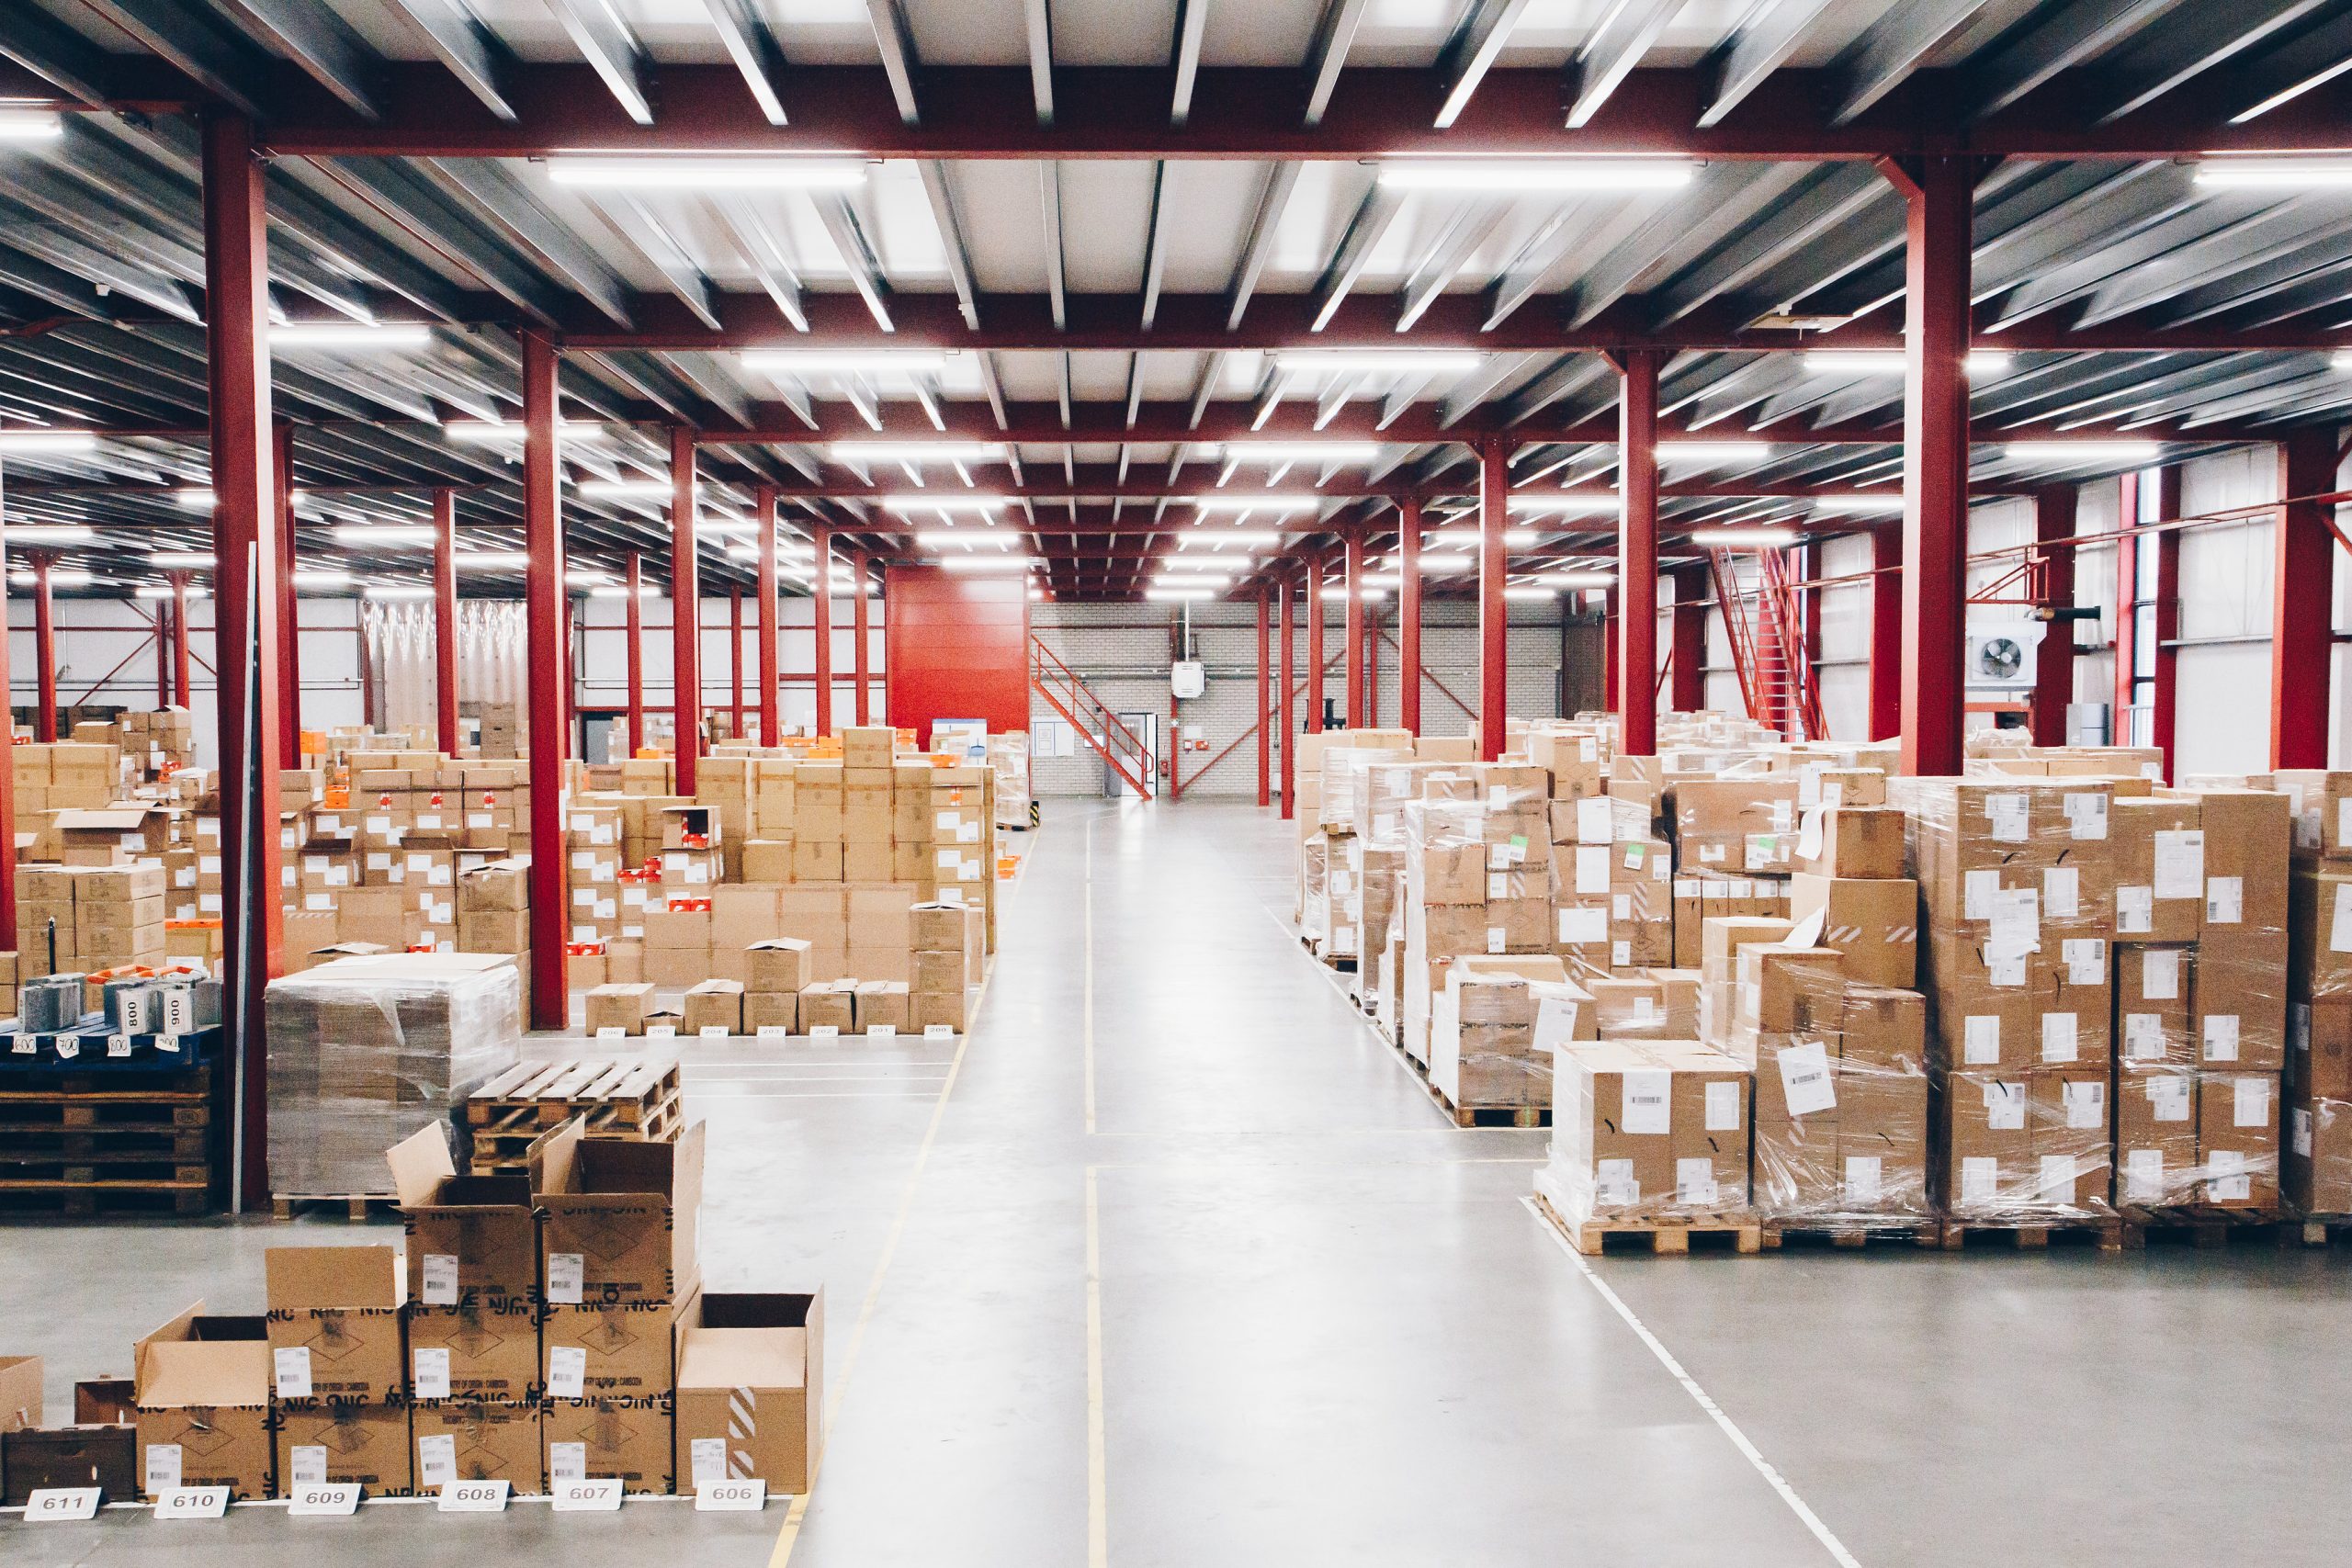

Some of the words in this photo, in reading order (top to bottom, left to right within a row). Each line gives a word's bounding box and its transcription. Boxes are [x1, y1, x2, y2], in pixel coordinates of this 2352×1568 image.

[127, 1001, 138, 1027] 800
[171, 999, 180, 1025] 900
[14, 1038, 36, 1052] 600
[59, 1038, 79, 1052] 700
[109, 1039, 128, 1053] 800
[306, 1492, 345, 1504] 609
[457, 1489, 496, 1501] 608
[570, 1487, 610, 1500] 607
[712, 1488, 752, 1500] 606
[43, 1496, 84, 1510] 611
[173, 1494, 215, 1508] 610
